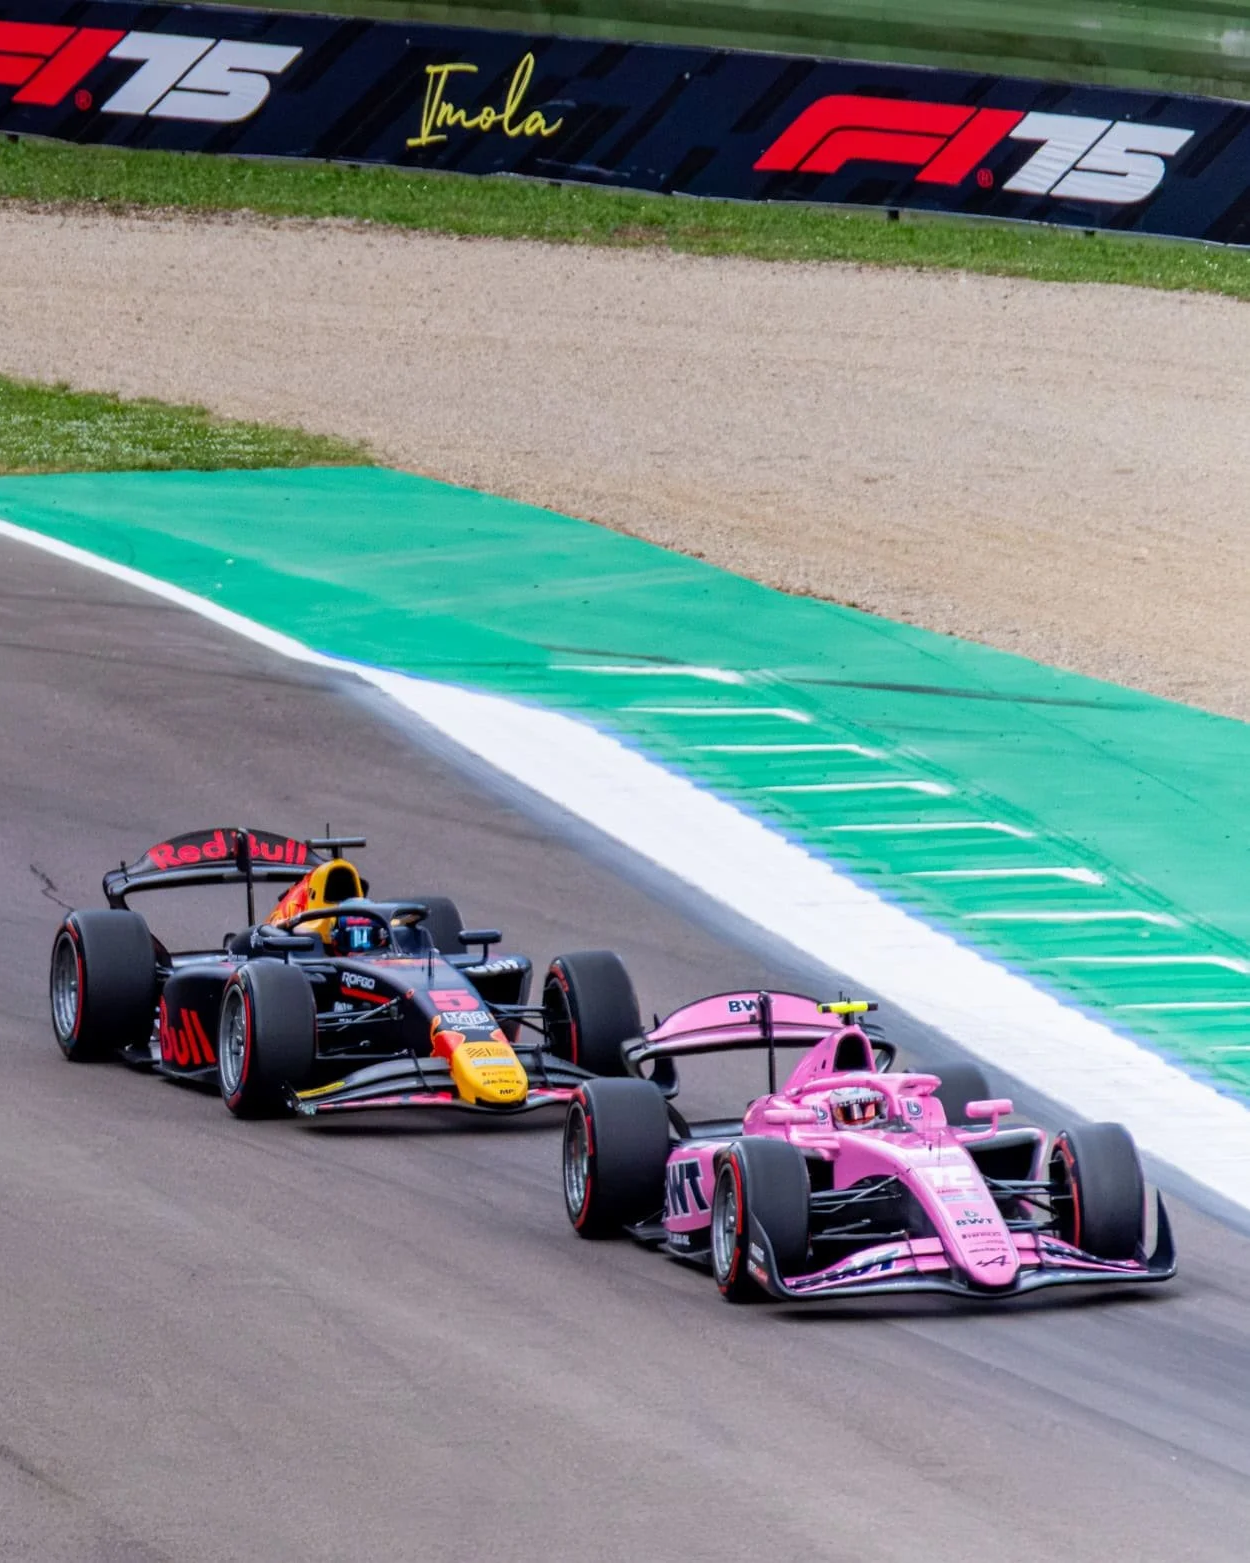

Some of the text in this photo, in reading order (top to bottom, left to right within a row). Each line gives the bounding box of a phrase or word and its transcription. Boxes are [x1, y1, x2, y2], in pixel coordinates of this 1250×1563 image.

[100, 31, 303, 122] 75
[405, 51, 562, 148] Imola
[753, 94, 1195, 203] F1 75
[148, 830, 307, 871] Red Bull
[159, 993, 216, 1067] Bull
[428, 989, 479, 1012] 5
[728, 999, 760, 1012] BW
[662, 1158, 711, 1222] WT
